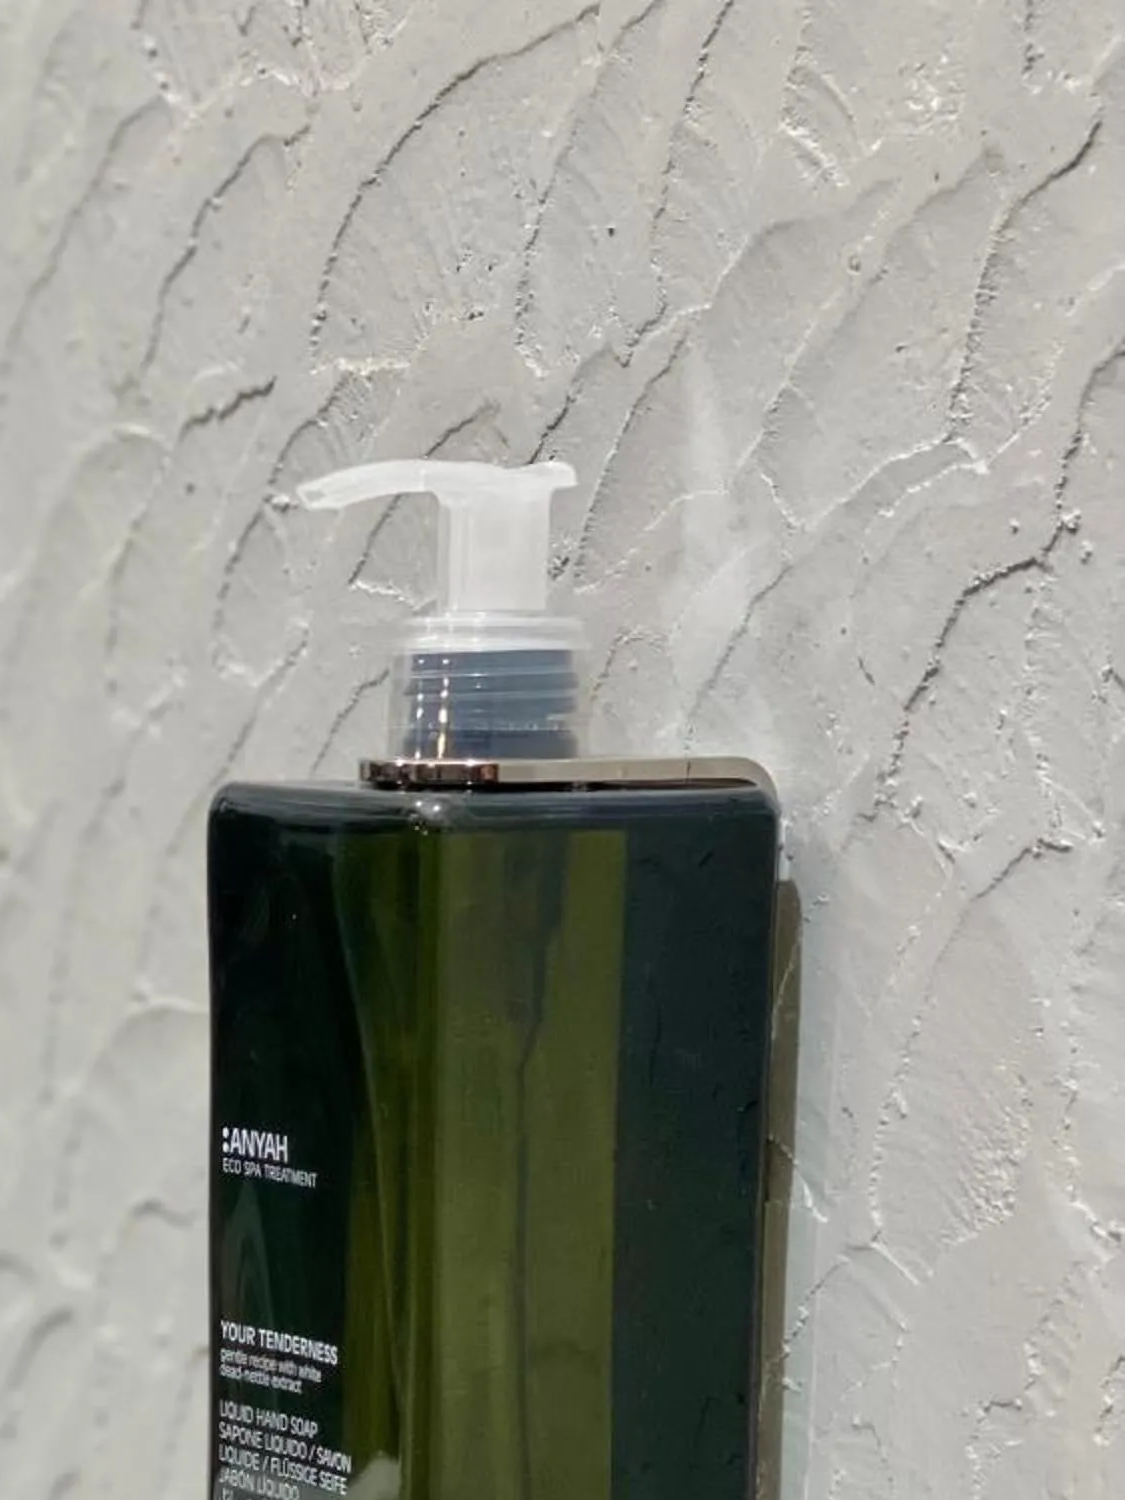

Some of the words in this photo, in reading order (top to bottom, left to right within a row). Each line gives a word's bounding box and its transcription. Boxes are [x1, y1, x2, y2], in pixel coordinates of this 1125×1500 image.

[222, 1158, 241, 1174] ECO
[243, 1161, 262, 1178] SPA
[264, 1164, 317, 1188] TREATMENT
[220, 1319, 255, 1346] YOUR
[257, 1328, 338, 1366] TENDERNESS
[219, 1399, 254, 1423] LIQUID
[256, 1407, 288, 1431] HAND
[290, 1416, 318, 1438] SOAP
[219, 1421, 263, 1449] SAPONE
[265, 1432, 307, 1460] LIQUIDO
[316, 1445, 352, 1474] SAVON
[219, 1444, 260, 1471] LIQUIDE
[319, 1470, 347, 1496] SEIFE
